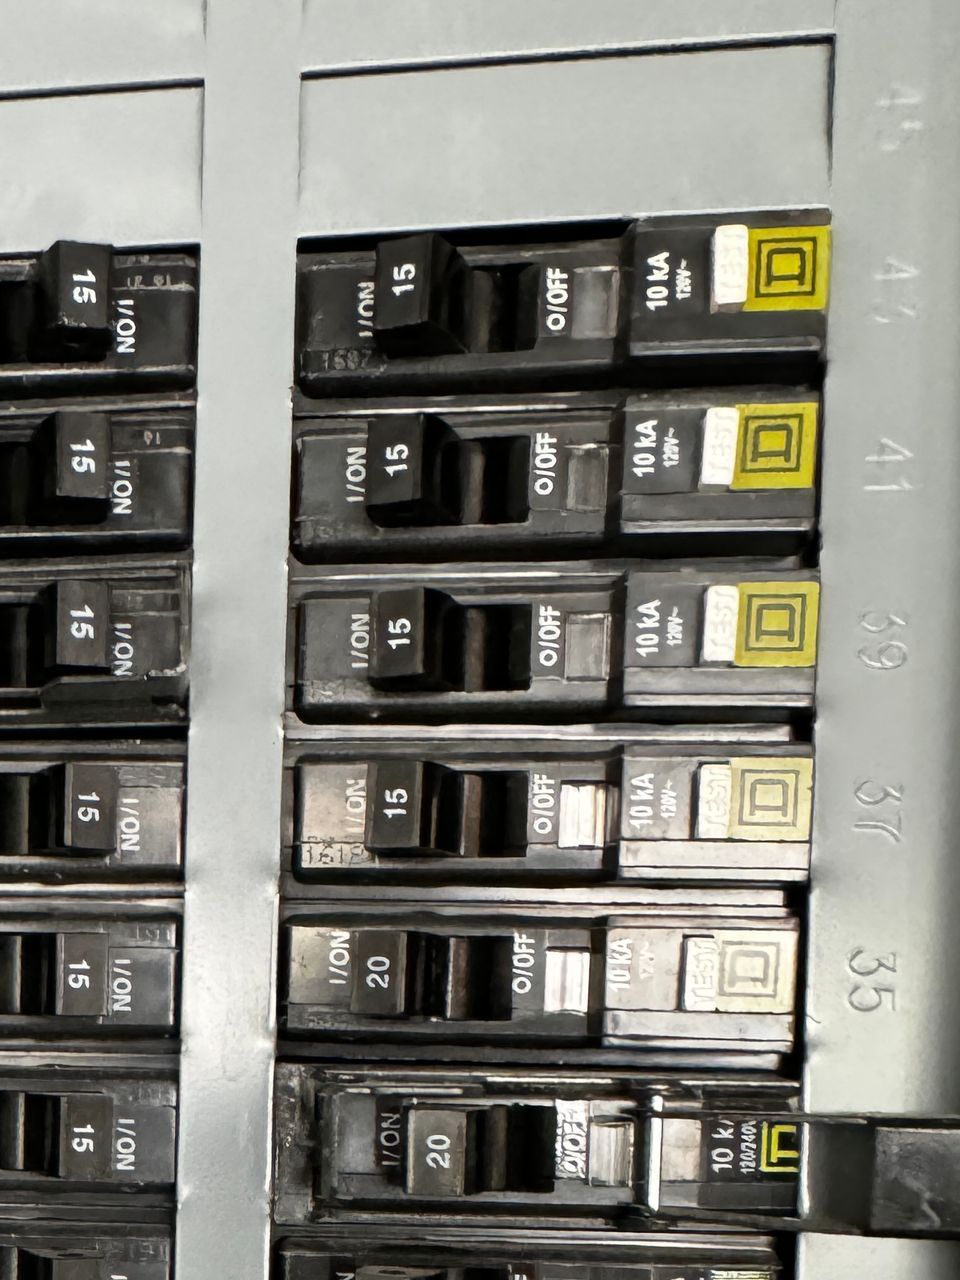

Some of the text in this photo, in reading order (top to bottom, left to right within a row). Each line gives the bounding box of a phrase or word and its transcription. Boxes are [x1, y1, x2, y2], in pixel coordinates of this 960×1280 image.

[72, 269, 96, 304] 15
[392, 263, 416, 297] 15
[646, 251, 669, 312] 10 kA
[117, 300, 136, 353] I/ON
[69, 440, 96, 474] 15
[384, 444, 408, 477] 15
[632, 420, 657, 478] 10 kA
[112, 461, 131, 515] I/ON
[346, 447, 366, 502] I/ON
[69, 605, 93, 640] 15
[350, 613, 370, 668] I/ON
[388, 618, 411, 650] 15
[637, 600, 661, 657] 10 kA
[77, 792, 99, 822] 15
[384, 788, 407, 819] 15
[630, 772, 655, 828] 10 kA
[854, 780, 904, 842] 37
[120, 799, 140, 851] I/ON
[68, 960, 90, 989] 15
[366, 957, 390, 989] 20
[848, 948, 897, 1012] 35
[72, 1124, 95, 1153] 15
[116, 1118, 135, 1170] I/ON
[426, 1134, 452, 1170] 20
[711, 1146, 735, 1173] 10
